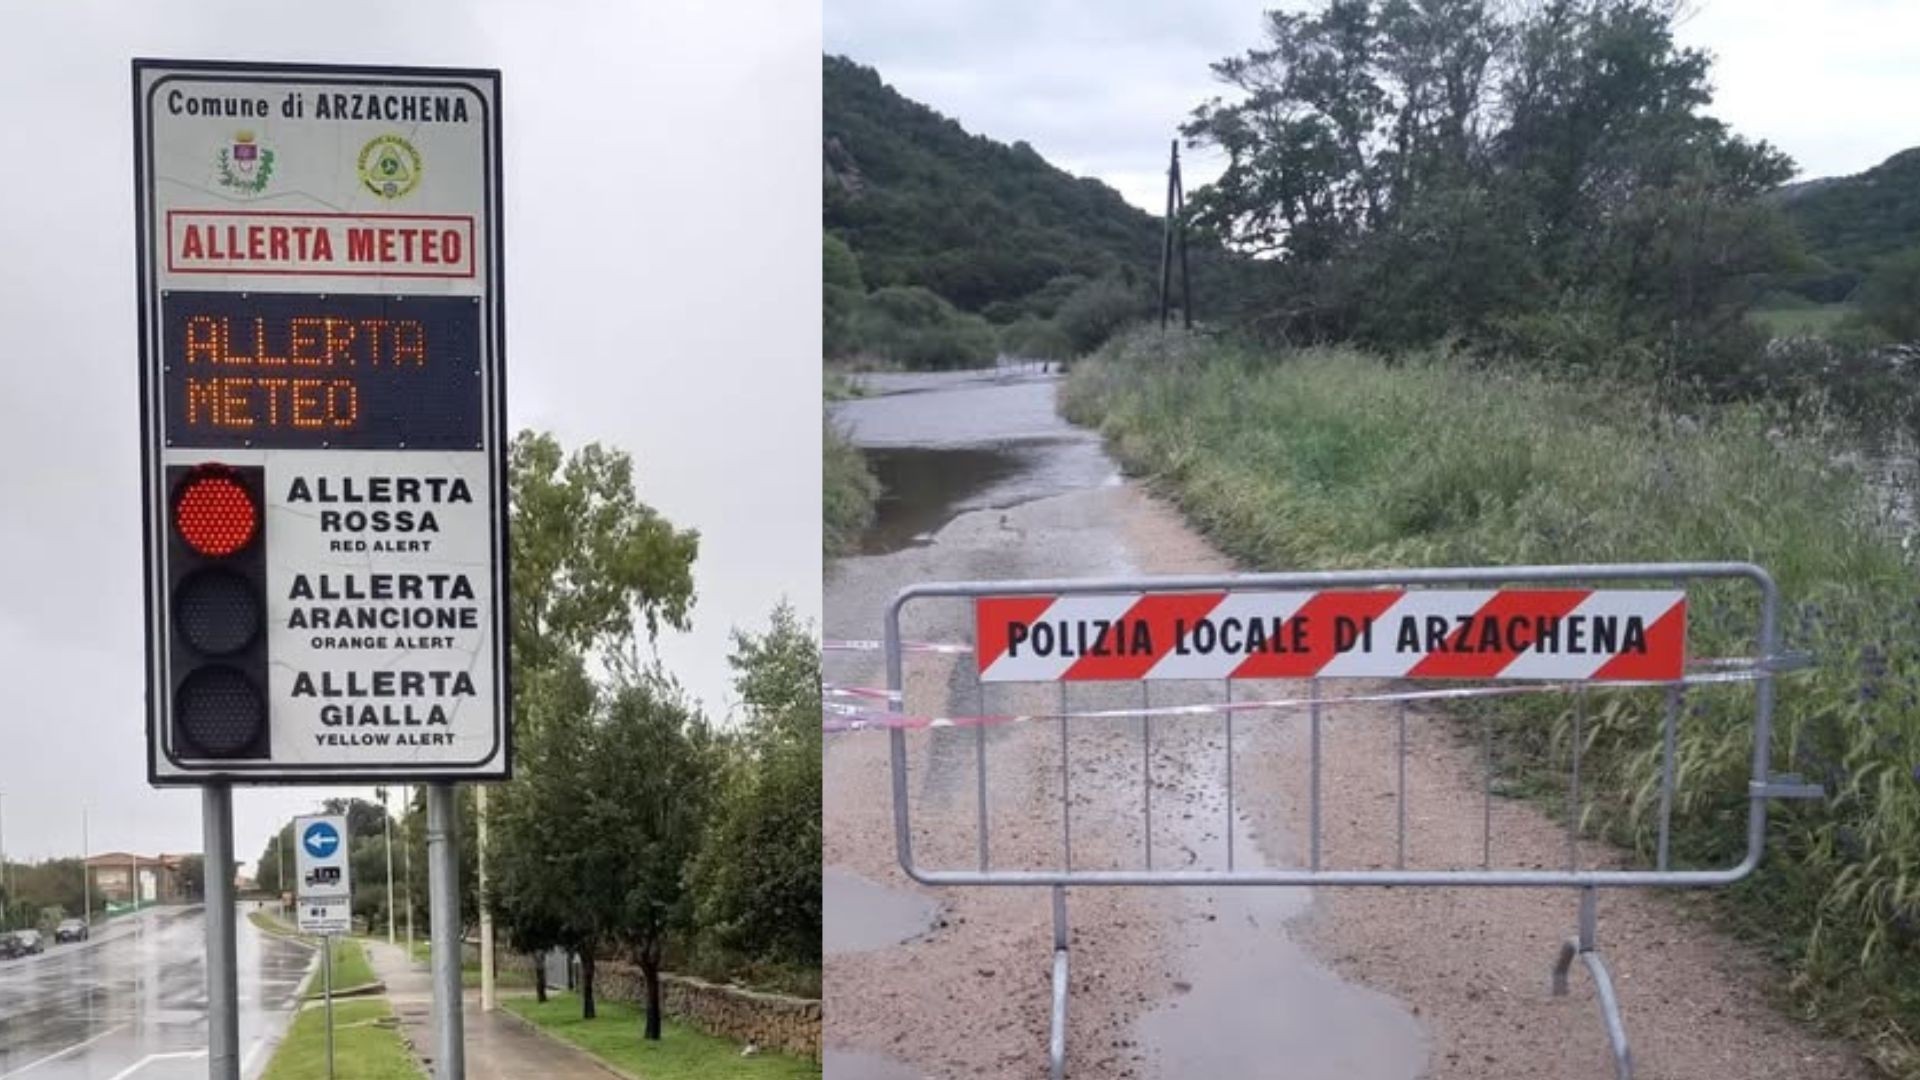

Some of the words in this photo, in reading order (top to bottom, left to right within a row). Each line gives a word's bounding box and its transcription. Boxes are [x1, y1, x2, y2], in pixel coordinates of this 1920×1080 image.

[168, 90, 269, 117] Comune
[282, 94, 303, 118] di
[316, 94, 469, 122] ARZACHENA
[181, 225, 333, 261] ALLERTA
[346, 227, 462, 264] METEO
[186, 315, 426, 367] ALLERTA
[187, 377, 358, 427] METEO
[287, 477, 473, 504] ALLERTA
[320, 511, 440, 533] ROSSA
[329, 540, 367, 552] RED
[373, 540, 432, 552] ALERT
[288, 574, 476, 600] ALLERTA
[287, 607, 479, 629] ARANCIONE
[311, 636, 388, 649] ORANGE
[394, 636, 456, 650] ALERT
[1007, 620, 1153, 659] POLIZIA
[1174, 615, 1309, 656] LOCALE
[1333, 615, 1374, 654] DI
[1396, 614, 1648, 655] ARZACHENA
[290, 671, 477, 698] ALLERTA
[320, 704, 448, 727] GIALLA
[315, 733, 389, 746] YELLOW
[396, 733, 456, 746] ALERT
